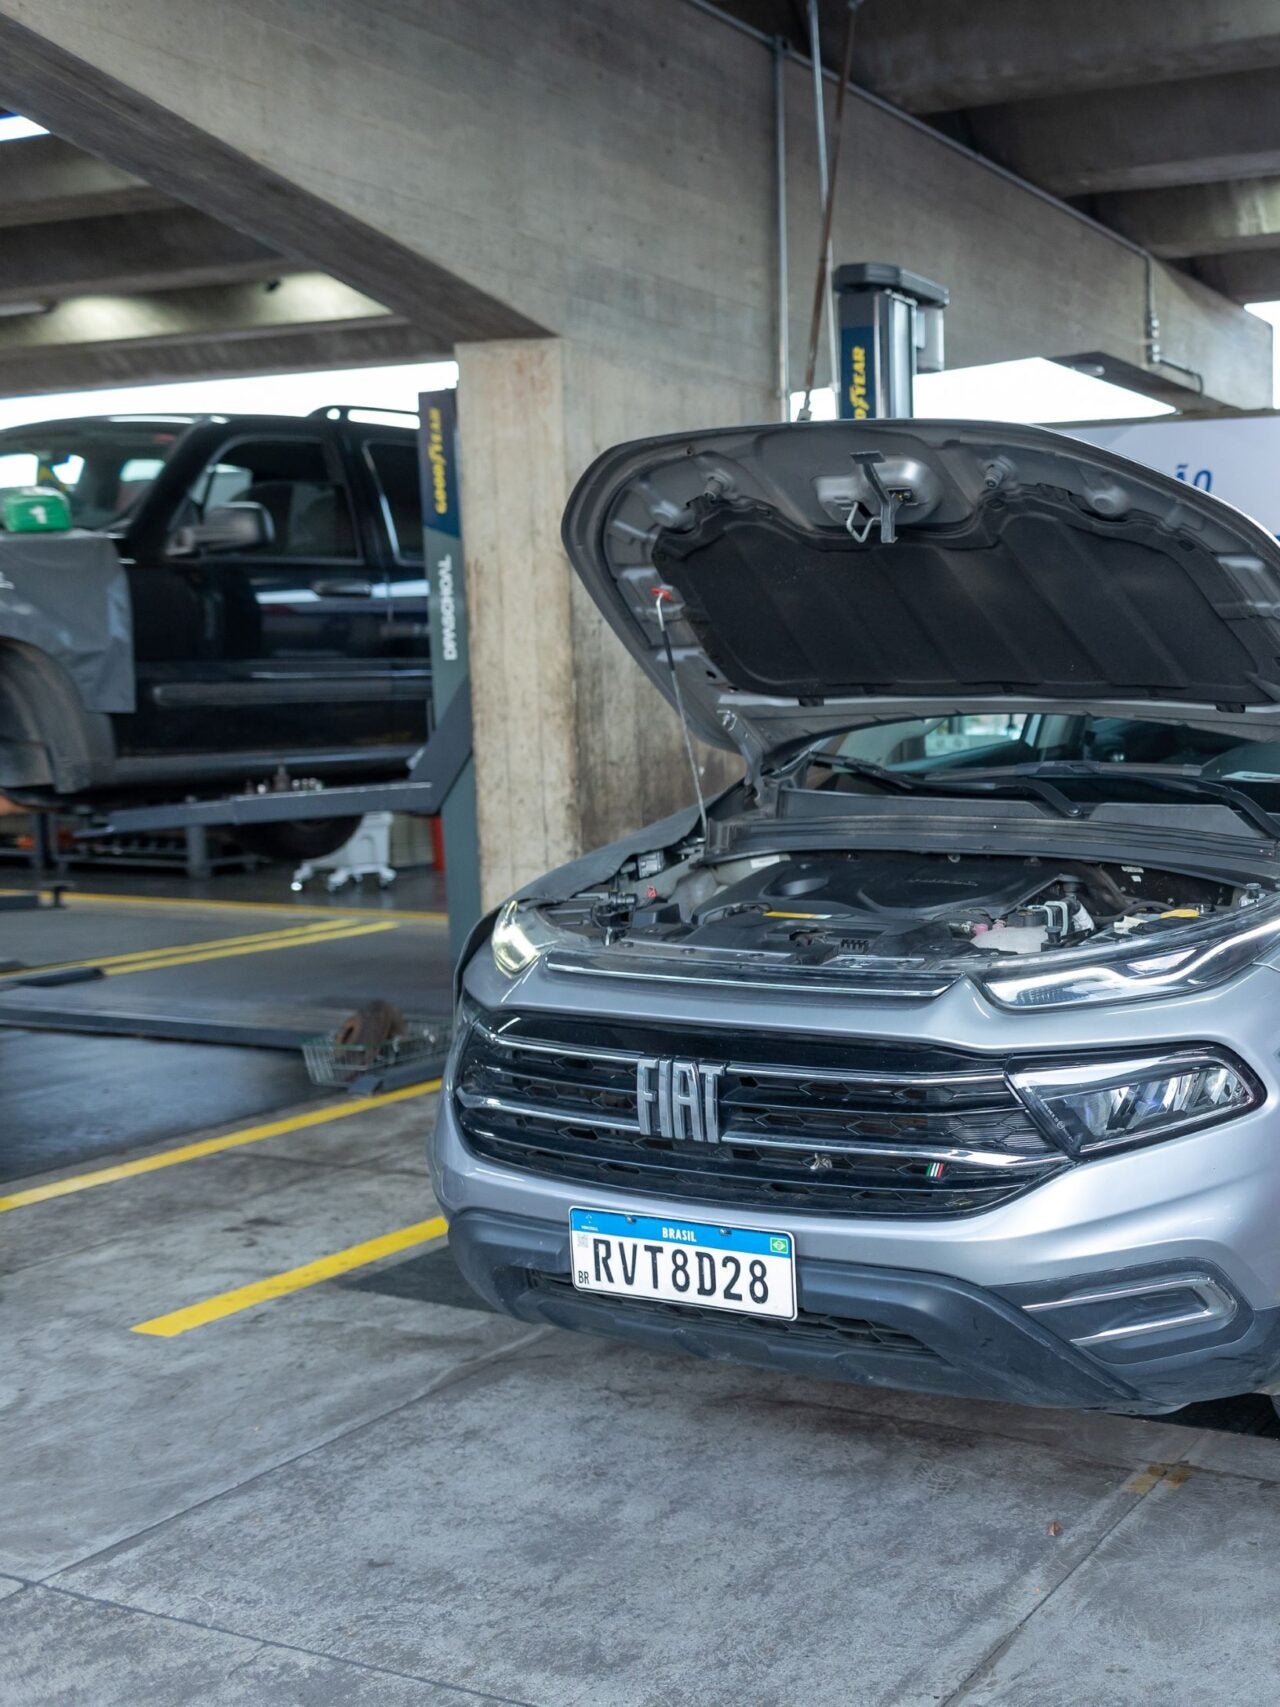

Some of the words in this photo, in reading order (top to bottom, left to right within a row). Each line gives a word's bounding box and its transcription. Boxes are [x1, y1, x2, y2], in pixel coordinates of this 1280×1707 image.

[428, 407, 447, 514] GOODYEAR
[28, 505, 48, 524] 1
[438, 553, 458, 661] DPASCHOAL
[636, 1055, 729, 1143] FIAT
[662, 1226, 697, 1243] BRASIL
[578, 1270, 590, 1284] BR
[593, 1238, 769, 1304] RVT8D28
